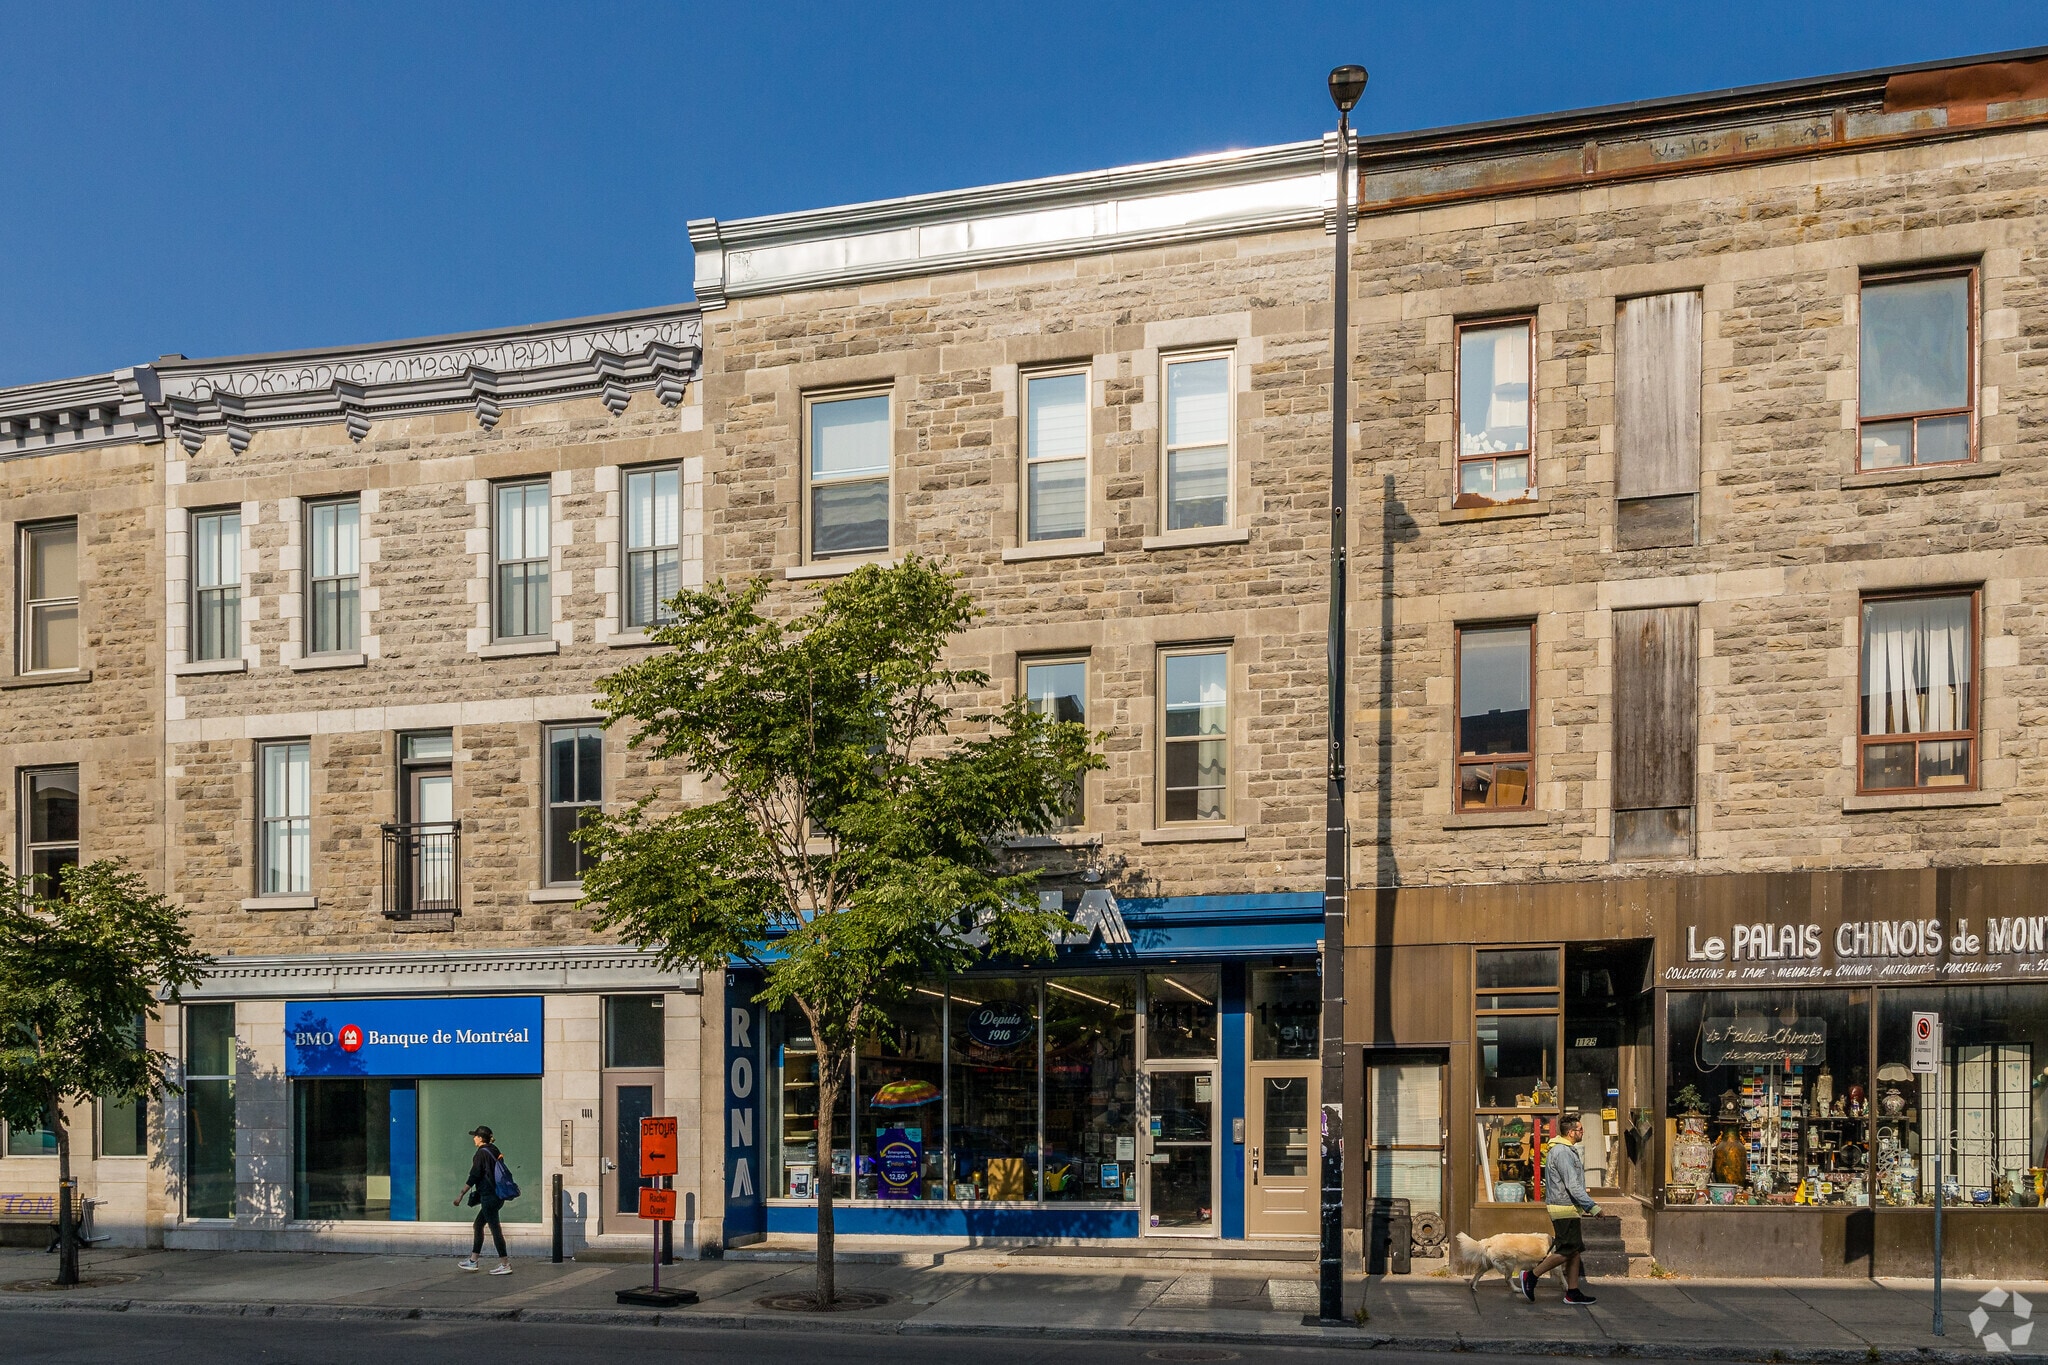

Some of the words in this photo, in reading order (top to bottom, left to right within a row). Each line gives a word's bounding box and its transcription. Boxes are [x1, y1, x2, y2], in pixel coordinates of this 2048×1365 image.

[1688, 925, 1727, 961] Le
[1732, 923, 1822, 961] PALAIS
[1835, 919, 1943, 958] CHINOIS
[1952, 917, 1980, 955] de
[1987, 915, 2048, 954] MON
[1665, 966, 1724, 979] COLLECTIONS
[1741, 967, 1768, 978] JADE
[1777, 966, 1823, 978] MEUBLES
[1835, 964, 1873, 977] CHINOIS
[1942, 961, 2003, 974] PORCELAINES
[979, 1010, 1021, 1027] Depuis
[295, 1031, 334, 1047] BMO
[368, 1030, 428, 1048] Banque
[433, 1029, 452, 1044] de
[455, 1028, 529, 1044] Montréal
[988, 1029, 1011, 1041] 1916
[731, 1008, 754, 1198] RONA
